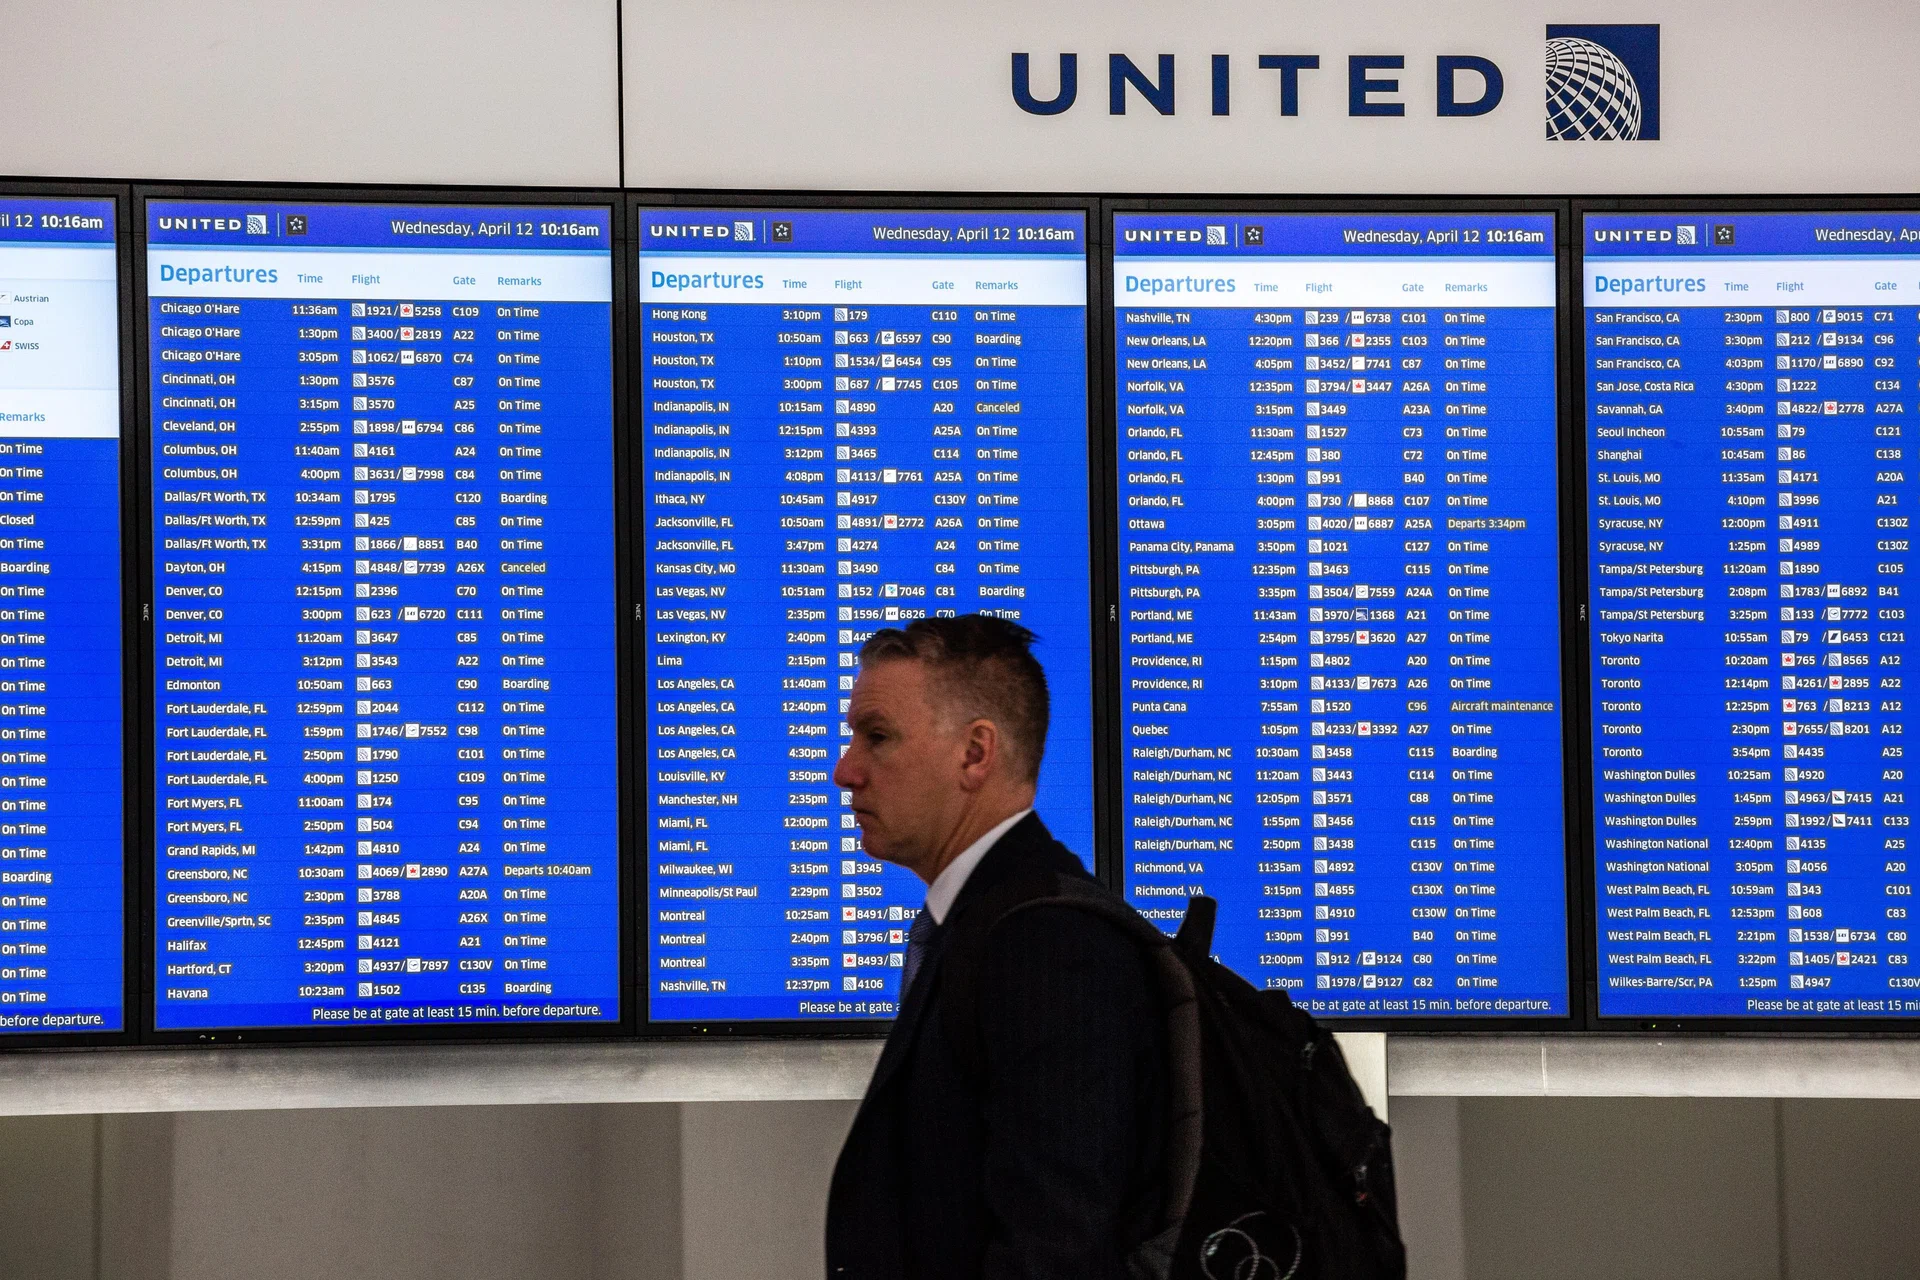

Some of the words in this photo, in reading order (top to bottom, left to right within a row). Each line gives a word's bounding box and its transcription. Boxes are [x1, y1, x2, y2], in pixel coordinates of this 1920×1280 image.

[1011, 52, 1505, 117] UNITED
[15, 214, 33, 228] 12
[41, 215, 103, 229] 10:16am
[159, 218, 242, 231] UNITED
[391, 221, 474, 237] Wednesday,
[478, 222, 511, 237] April
[516, 223, 533, 236] 12
[540, 223, 599, 237] 10:16am
[650, 225, 730, 238] UNITED
[873, 227, 953, 243] Wednesday,
[956, 227, 989, 243] April
[993, 227, 1010, 241] 12
[1017, 228, 1075, 241] 10:16am
[1815, 228, 1896, 243] Wednesday,
[1125, 230, 1202, 242] UNITED
[1343, 230, 1423, 245] Wednesday,
[1426, 230, 1458, 245] April
[1463, 230, 1480, 243] 12
[1486, 230, 1544, 243] 10:16am
[1594, 230, 1672, 243] UNITED
[160, 264, 279, 286] Departures
[297, 274, 323, 284] Time
[351, 274, 381, 286] Flight
[452, 276, 476, 286] Gate
[497, 276, 542, 287] Remarks
[651, 271, 764, 292] Departures
[782, 280, 808, 289] Time
[834, 280, 862, 291] Flight
[932, 281, 955, 290] Gate
[975, 281, 1019, 290] Remarks
[1125, 275, 1236, 296] Departures
[1253, 282, 1279, 292] Time
[1305, 282, 1333, 294] Flight
[1401, 283, 1425, 292] Gate
[1444, 282, 1488, 292] Remarks
[1595, 275, 1706, 297] Departures
[1724, 282, 1749, 292] Time
[1776, 282, 1804, 293] Flight
[1874, 281, 1897, 291] Gate
[13, 294, 50, 303] Austrian
[13, 317, 34, 327] Copa
[652, 309, 680, 321] Hong
[681, 309, 707, 322] Kong
[783, 310, 821, 322] 3:10pm
[848, 310, 868, 321] 179
[931, 311, 958, 321] C110
[975, 311, 989, 321] On
[990, 310, 1016, 322] Time
[14, 342, 40, 351] SWISS
[162, 373, 217, 386] Cincinnati,
[218, 374, 235, 385] OH
[300, 375, 339, 388] 1:30pm
[367, 376, 395, 386] 3576
[453, 377, 474, 387] C87
[498, 377, 513, 387] On
[514, 376, 541, 388] Time
[1596, 382, 1615, 392] San
[1616, 382, 1642, 393] Jose,
[1644, 382, 1672, 392] Costa
[1673, 381, 1694, 392] Rica
[1725, 381, 1764, 393] 4:30pm
[1791, 381, 1817, 391] 1222
[1874, 380, 1900, 391] C134
[0, 412, 46, 422] Remarks
[1127, 404, 1168, 416] Norfolk,
[1169, 405, 1185, 415] VA
[1255, 405, 1293, 417] 3:15pm
[1320, 404, 1347, 415] 3449
[1402, 404, 1431, 415] A23A
[1445, 404, 1460, 415] On
[1460, 404, 1487, 415] Time
[1597, 449, 1642, 462] Shanghai
[1721, 450, 1765, 460] 10:45am
[1792, 449, 1806, 459] 86
[1876, 449, 1902, 459] C138
[655, 494, 688, 506] Ithaca,
[690, 494, 706, 505] NY
[780, 494, 824, 505] 10:45am
[850, 494, 878, 505] 4917
[934, 495, 967, 505] C130Y
[977, 495, 992, 505] On
[993, 494, 1019, 505] Time
[0, 514, 34, 526] Closed
[0, 562, 50, 575] Boarding
[165, 562, 207, 575] Dayton,
[208, 563, 225, 573] OH
[301, 563, 342, 575] 4:15pm
[418, 563, 446, 573] 7739
[456, 563, 485, 573] A26X
[501, 562, 546, 573] Canceled
[657, 655, 683, 666] Lima
[787, 655, 826, 668] 2:15pm
[166, 680, 221, 691] Edmonton
[297, 680, 343, 690] 10:50am
[371, 679, 392, 690] 663
[457, 679, 478, 690] C90
[502, 678, 550, 691] Boarding
[1132, 702, 1161, 713] Punta
[1162, 702, 1187, 712] Cana
[1261, 702, 1298, 712] 7:55am
[1325, 701, 1351, 712] 1520
[1407, 702, 1427, 712] C96
[1451, 701, 1489, 712] Aircraft
[1491, 701, 1554, 712] maintenance
[1133, 747, 1215, 760] Raleigh/Durham,
[1217, 748, 1232, 758] NC
[1256, 748, 1299, 758] 10:30am
[1326, 747, 1353, 758] 3458
[1408, 747, 1434, 758] C115
[1452, 746, 1498, 759] Boarding
[1602, 747, 1643, 758] Toronto
[1732, 747, 1771, 759] 3:54pm
[1797, 747, 1824, 757] 4435
[1882, 747, 1903, 757] A25
[1, 824, 17, 835] On
[18, 823, 47, 835] Time
[2, 871, 52, 884] Boarding
[659, 887, 734, 899] Minneapolis/St
[735, 887, 757, 897] Paul
[790, 887, 829, 899] 2:29pm
[856, 886, 882, 896] 3502
[1606, 885, 1633, 895] West
[1634, 884, 1660, 895] Palm
[1662, 884, 1696, 896] Beach,
[1697, 885, 1710, 895] FL
[1731, 885, 1774, 895] 10:59am
[1801, 885, 1822, 895] 343
[1885, 885, 1911, 896] C101
[1, 992, 17, 1003] On
[18, 991, 47, 1003] Time
[167, 989, 208, 999] Havana
[299, 986, 345, 997] 10:23am
[373, 984, 401, 995] 1502
[459, 983, 486, 994] C135
[505, 982, 552, 995] Boarding
[1312, 999, 1326, 1011] be
[1328, 1000, 1340, 1011] at
[1342, 1000, 1366, 1012] gate
[1369, 1000, 1380, 1011] at
[1383, 999, 1409, 1011] least
[1412, 999, 1426, 1011] 15
[1429, 999, 1453, 1010] min.
[1455, 999, 1492, 1011] before
[1494, 999, 1551, 1012] departure.
[313, 1008, 350, 1020] Please
[353, 1008, 368, 1020] be
[370, 1008, 382, 1019] at
[385, 1007, 410, 1021] gate
[412, 1007, 424, 1019] at
[427, 1006, 455, 1018] least
[458, 1006, 472, 1018] 15
[475, 1005, 500, 1017] min.
[503, 1005, 540, 1017] before
[542, 1005, 601, 1018] departure.
[0, 1014, 39, 1027] before
[42, 1014, 104, 1027] departure.
